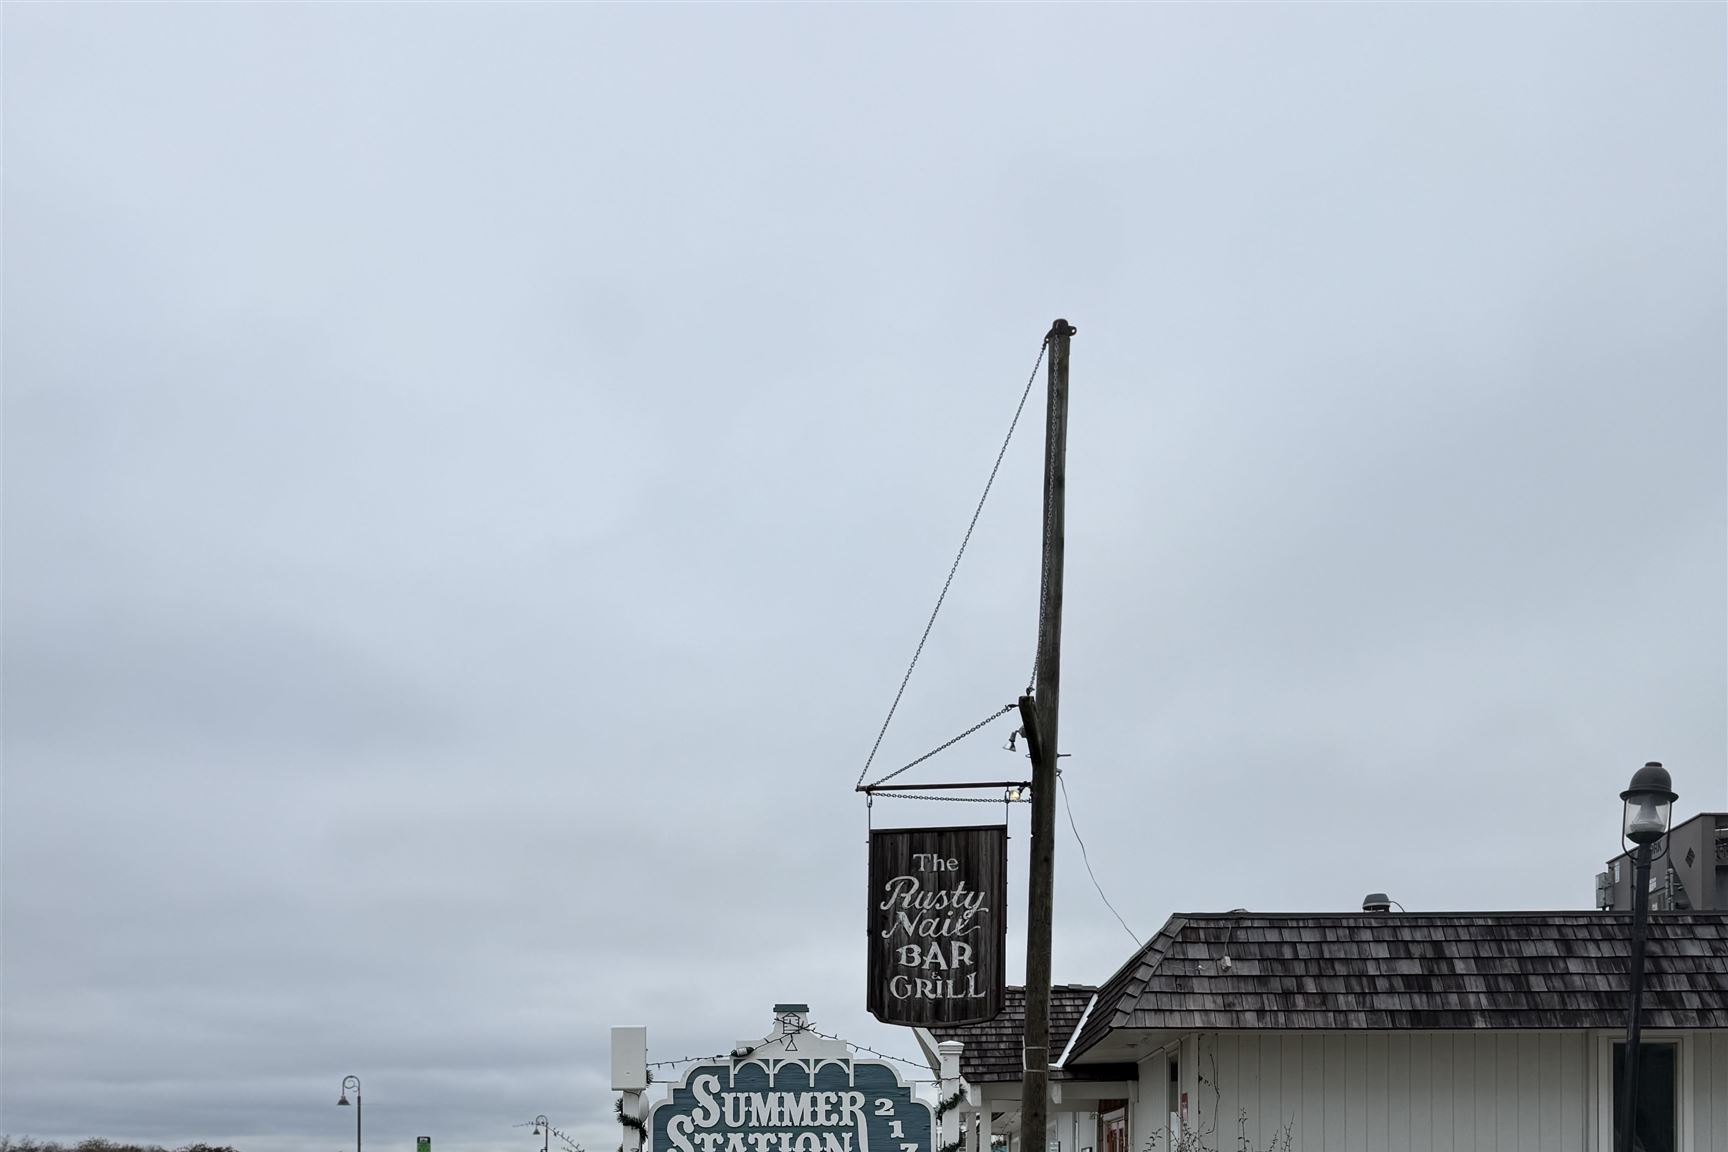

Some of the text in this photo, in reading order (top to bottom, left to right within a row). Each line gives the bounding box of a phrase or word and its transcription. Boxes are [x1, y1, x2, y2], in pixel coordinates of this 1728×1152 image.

[912, 853, 959, 872] The
[880, 875, 989, 919] Rusty
[881, 909, 981, 939] Nail
[896, 940, 974, 970] BAR
[889, 971, 986, 1000] GRILL
[931, 971, 941, 980] &
